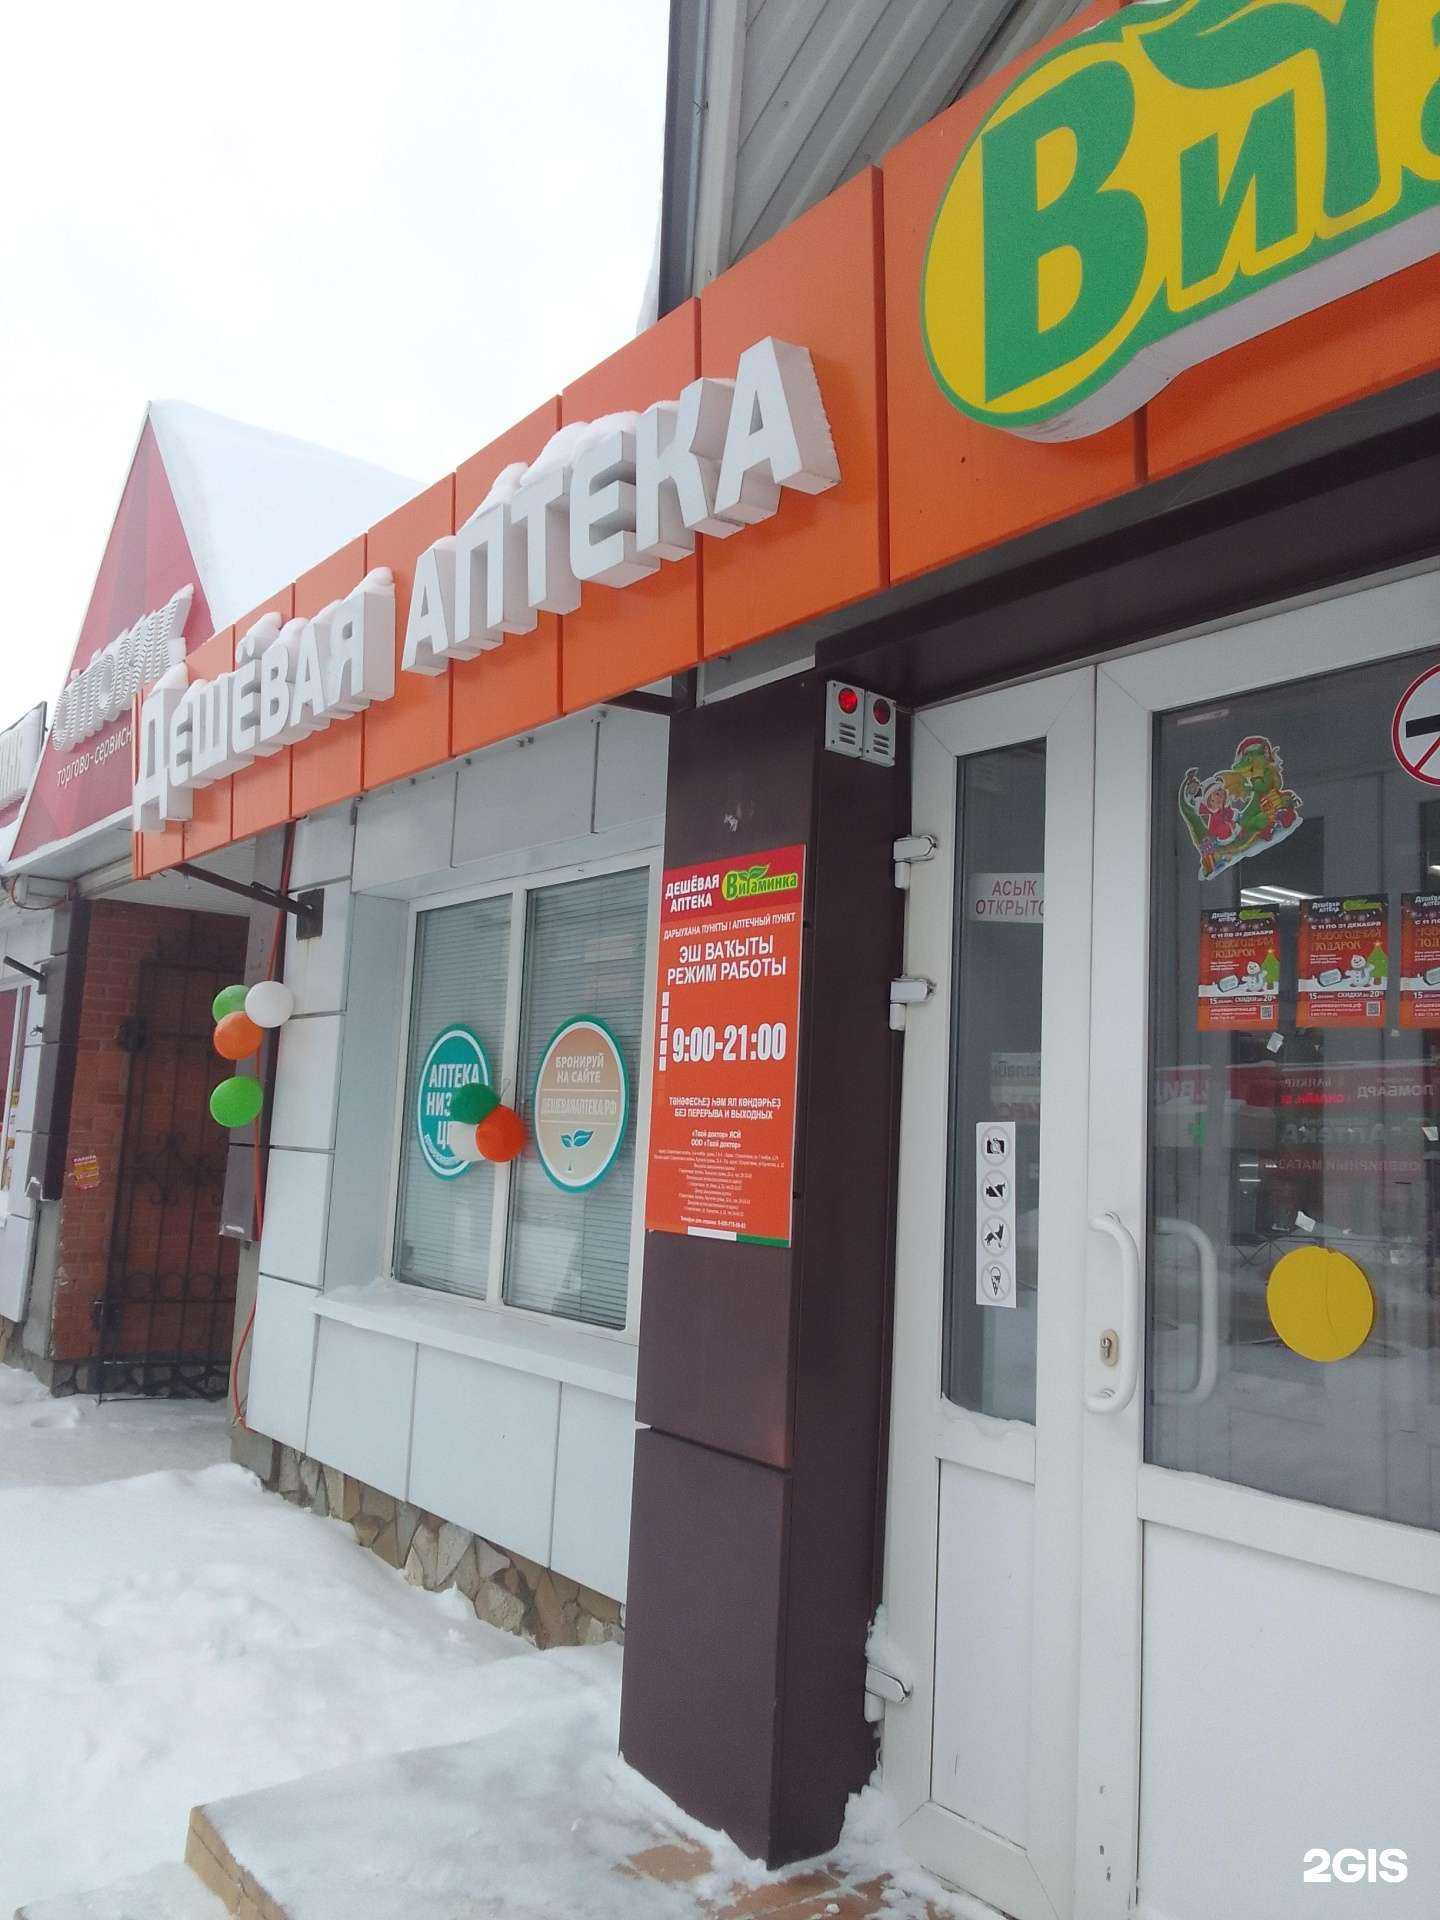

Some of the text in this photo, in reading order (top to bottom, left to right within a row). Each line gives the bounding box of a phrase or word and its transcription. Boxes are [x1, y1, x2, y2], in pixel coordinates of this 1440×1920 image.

[133, 336, 835, 832] ДЕШЁВАЯ АПТЕКА
[57, 722, 133, 789] торгово-сервисн
[665, 870, 799, 900] ДЕШЁВАЯ Витаминка
[670, 893, 712, 912] АПТЕКА
[701, 922, 729, 934] ПУНКТЫ
[732, 914, 771, 930] АПТЕЧНЫЙ
[772, 912, 796, 924] ПУНКТ
[1347, 921, 1382, 929] ДЕКАБРЯ
[679, 944, 701, 964] ЭШ
[667, 957, 787, 986] РЕЖИМ РАБОТЫ
[1414, 991, 1423, 999] 15
[672, 1023, 786, 1062] 9:00-21:00
[555, 1053, 605, 1069] БРОНИРУЙ
[429, 1063, 479, 1088] АПТЕКА
[557, 1069, 602, 1084] НА САЙТЕ
[426, 1091, 452, 1117] НИЗ
[728, 1097, 737, 1107] ЯЛ
[674, 1107, 686, 1118] БЕЗ
[687, 1108, 724, 1119] ПЕРЕРЫВА
[731, 1109, 773, 1120] ВЫХОДНЫХ
[691, 1139, 703, 1147] ООО
